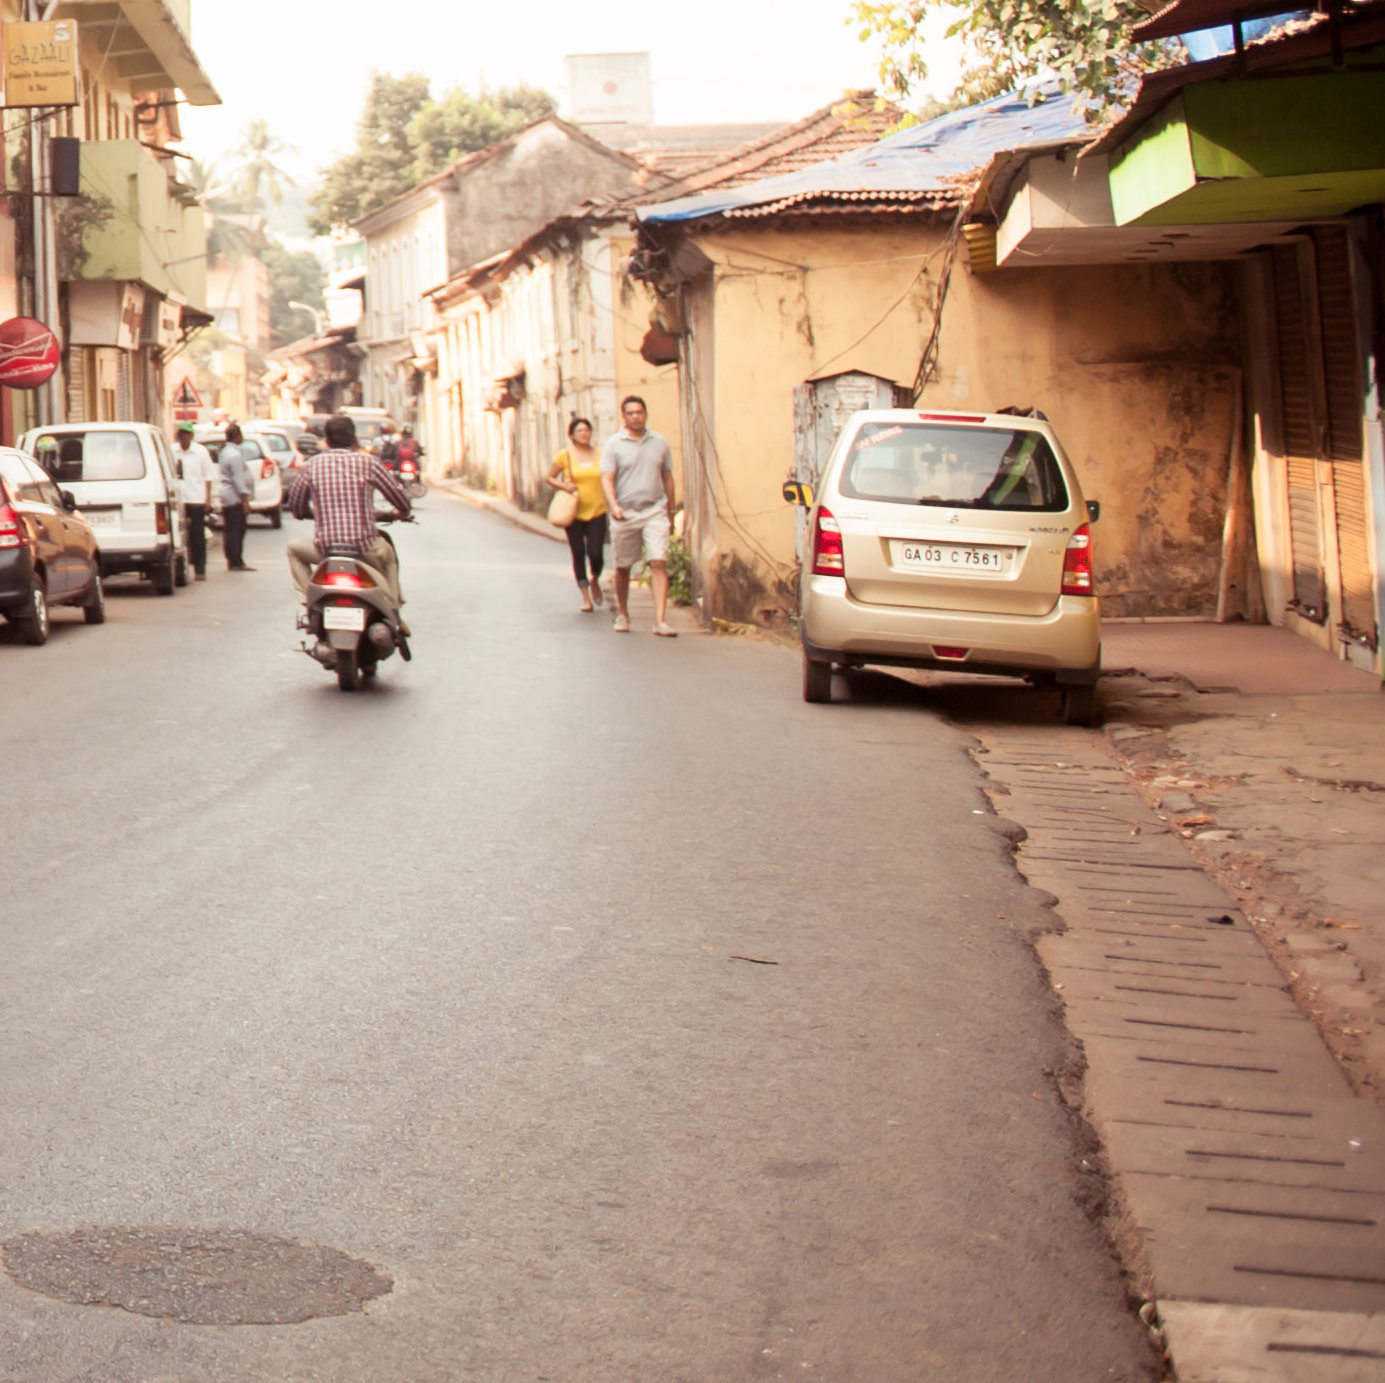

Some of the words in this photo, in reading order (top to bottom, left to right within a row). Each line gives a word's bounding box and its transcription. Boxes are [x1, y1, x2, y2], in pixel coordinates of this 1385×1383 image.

[905, 549, 921, 560] GA
[925, 549, 941, 561] 03
[951, 550, 959, 562] C
[964, 550, 999, 566] 7561
